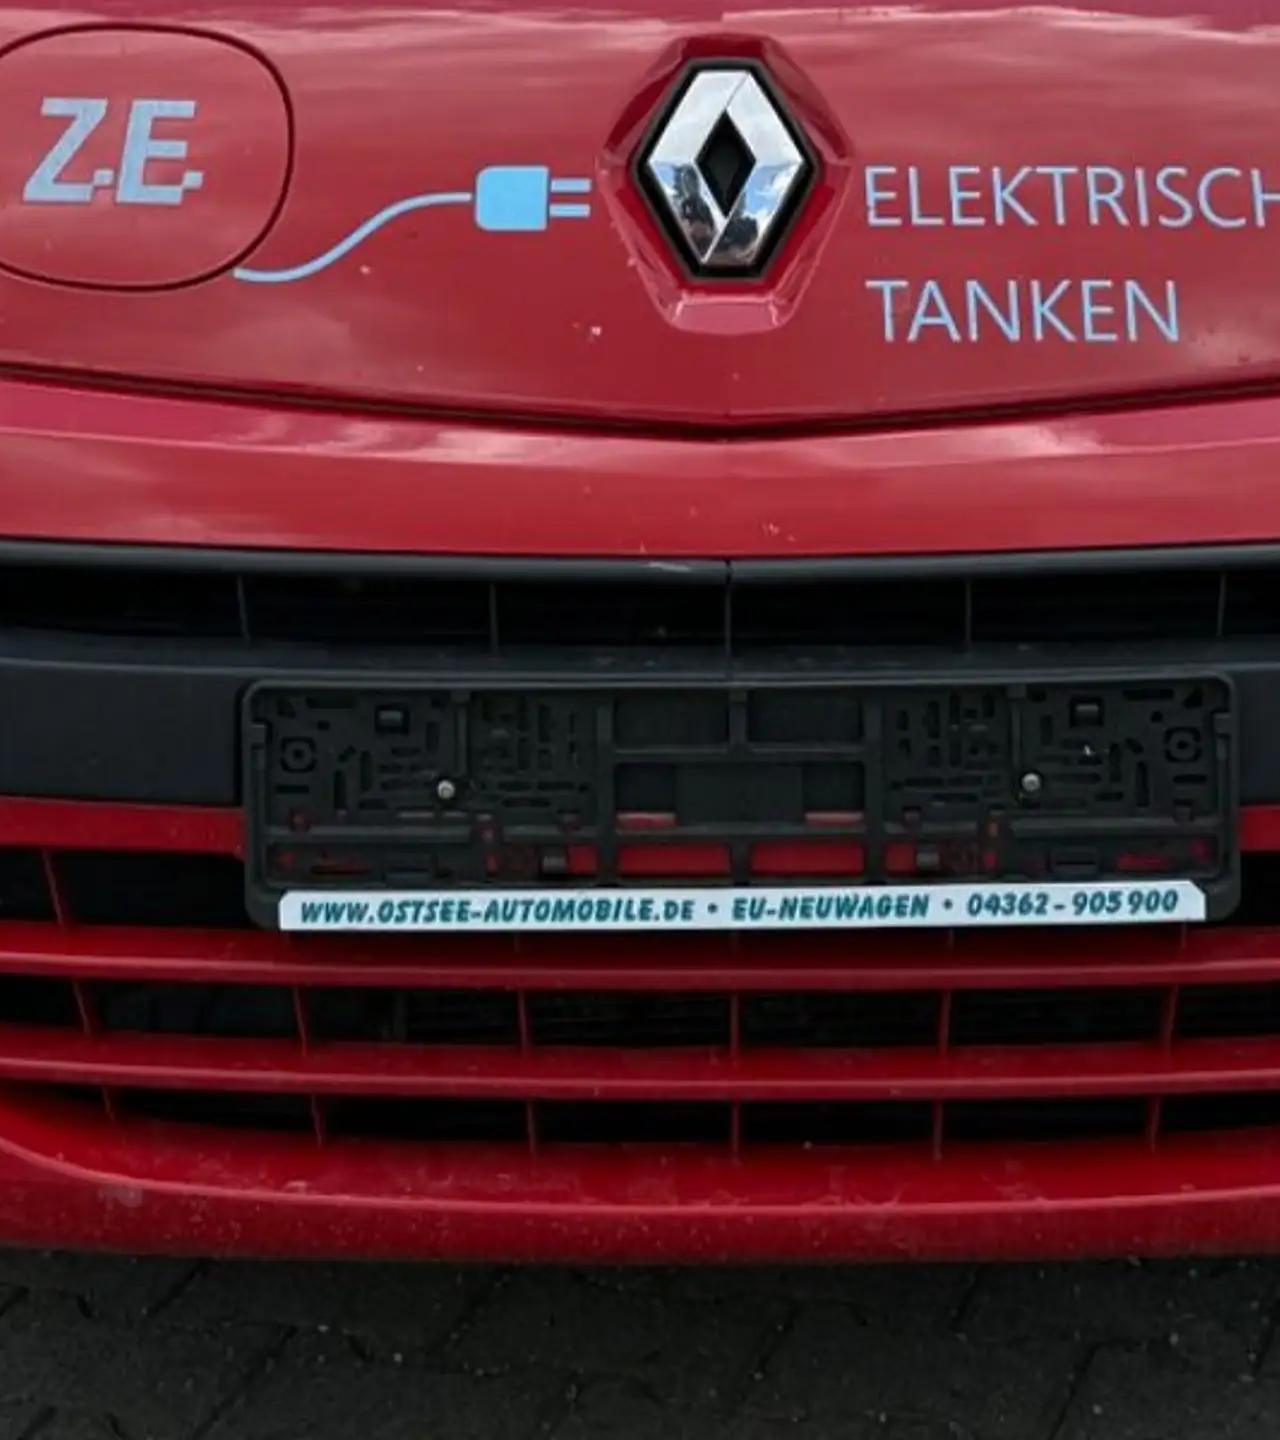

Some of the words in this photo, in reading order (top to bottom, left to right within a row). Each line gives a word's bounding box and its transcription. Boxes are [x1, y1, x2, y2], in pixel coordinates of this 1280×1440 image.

[23, 97, 204, 205] Z.E.
[865, 279, 1180, 342] TANKEN
[300, 898, 695, 923] WWW.OSTSEE-AUTOMOBILE.DE
[731, 893, 930, 921] EU-NEUWAGEN
